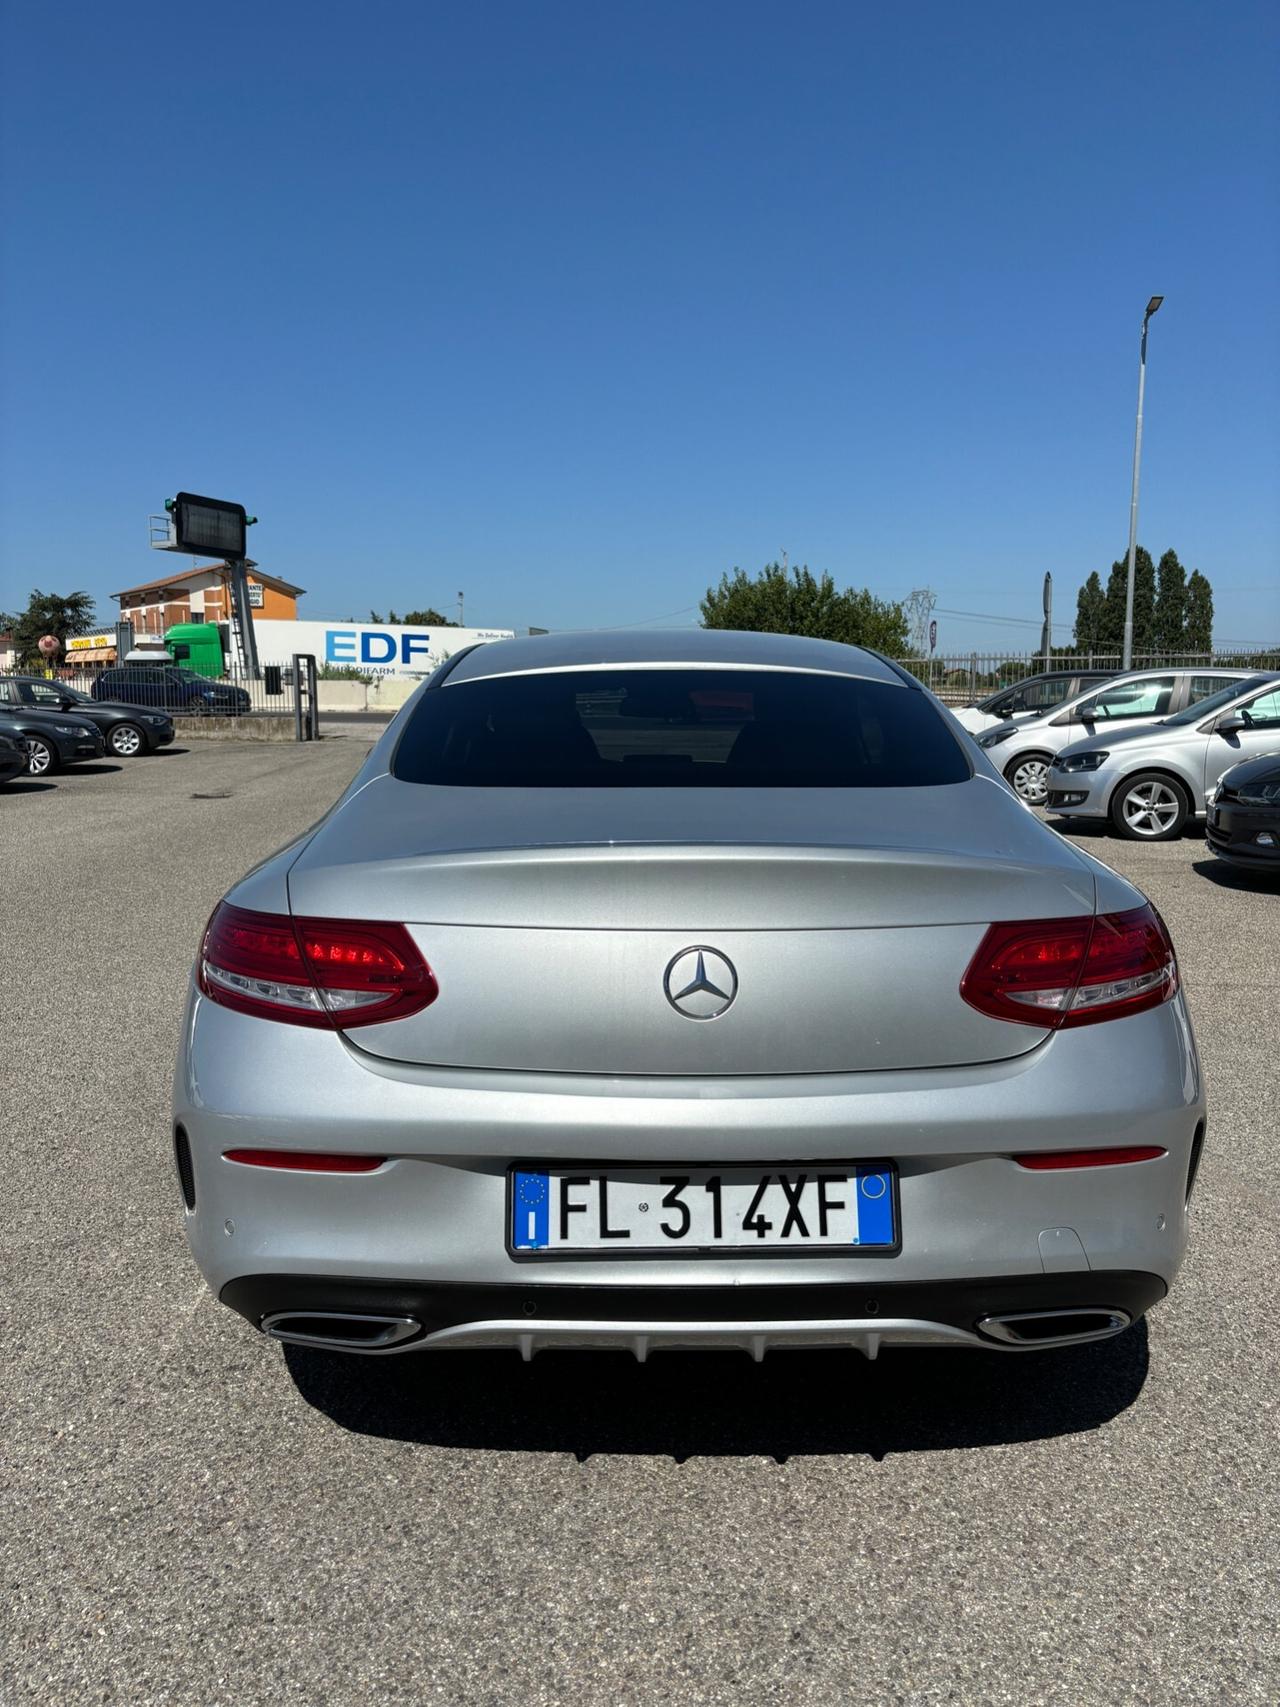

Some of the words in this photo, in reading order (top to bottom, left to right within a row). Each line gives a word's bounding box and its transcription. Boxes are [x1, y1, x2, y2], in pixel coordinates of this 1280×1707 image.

[326, 631, 430, 664] EDF
[560, 1176, 630, 1239] FL
[660, 1174, 848, 1239] 314XF
